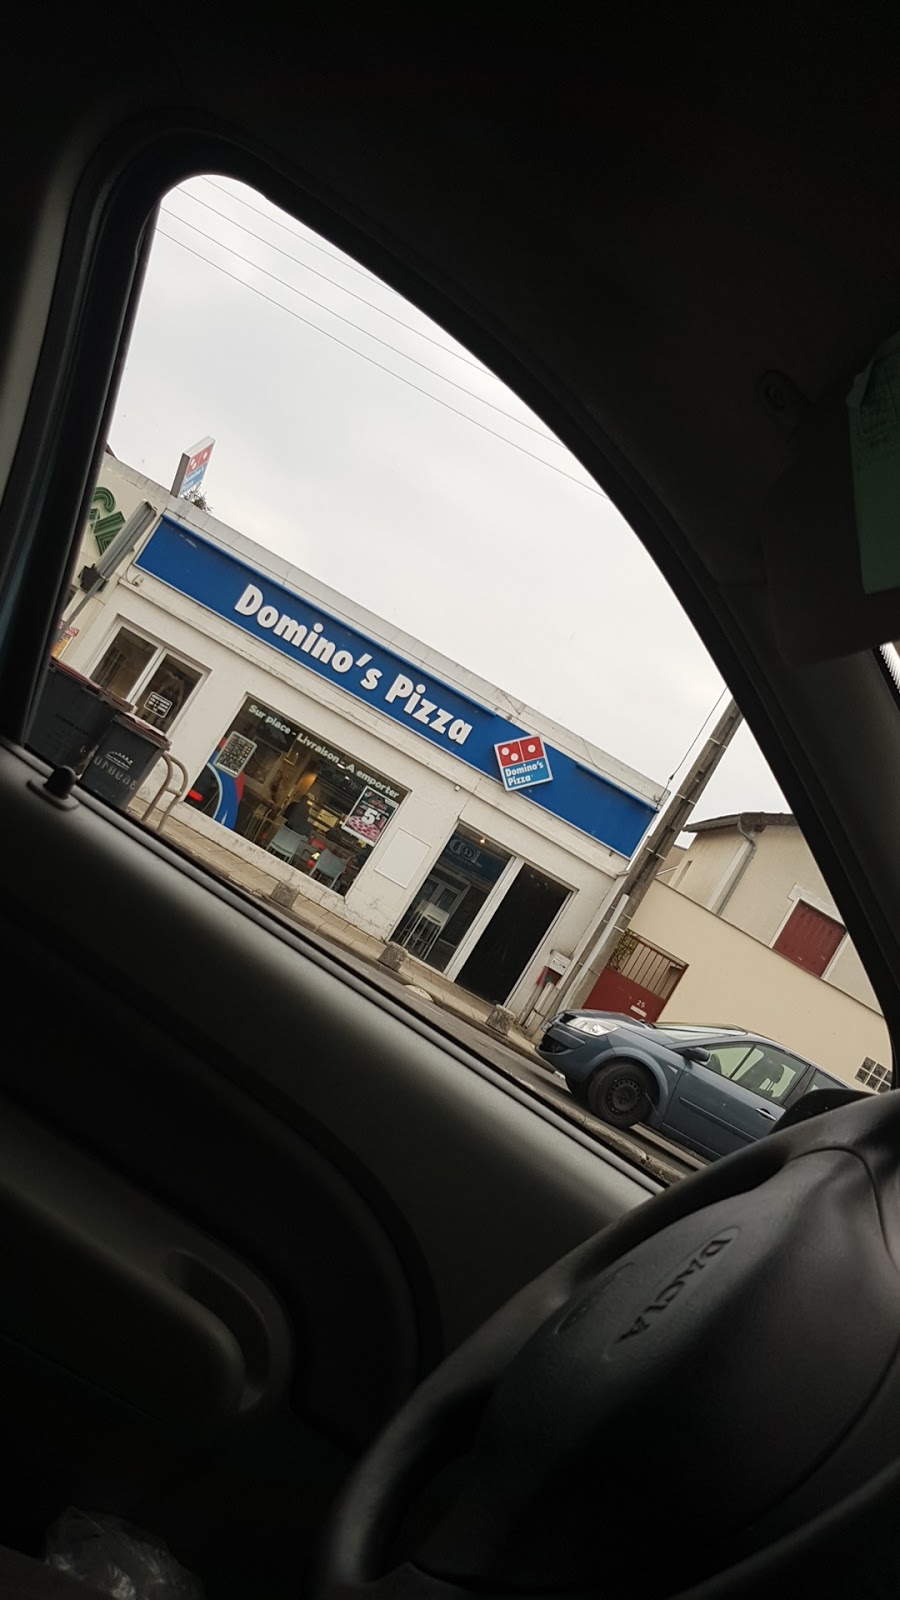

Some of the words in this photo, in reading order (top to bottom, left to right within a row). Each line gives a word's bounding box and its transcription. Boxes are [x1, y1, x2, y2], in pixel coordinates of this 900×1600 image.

[234, 584, 383, 690] Domino's
[385, 673, 473, 745] Pizza
[249, 704, 266, 719] Sur
[265, 715, 291, 735] place
[296, 732, 340, 763] Livraison
[346, 763, 355, 774] A
[356, 770, 400, 799] emporter
[505, 760, 544, 777] Domino's
[507, 775, 532, 786] Pizza
[614, 1237, 734, 1344] DACIA
